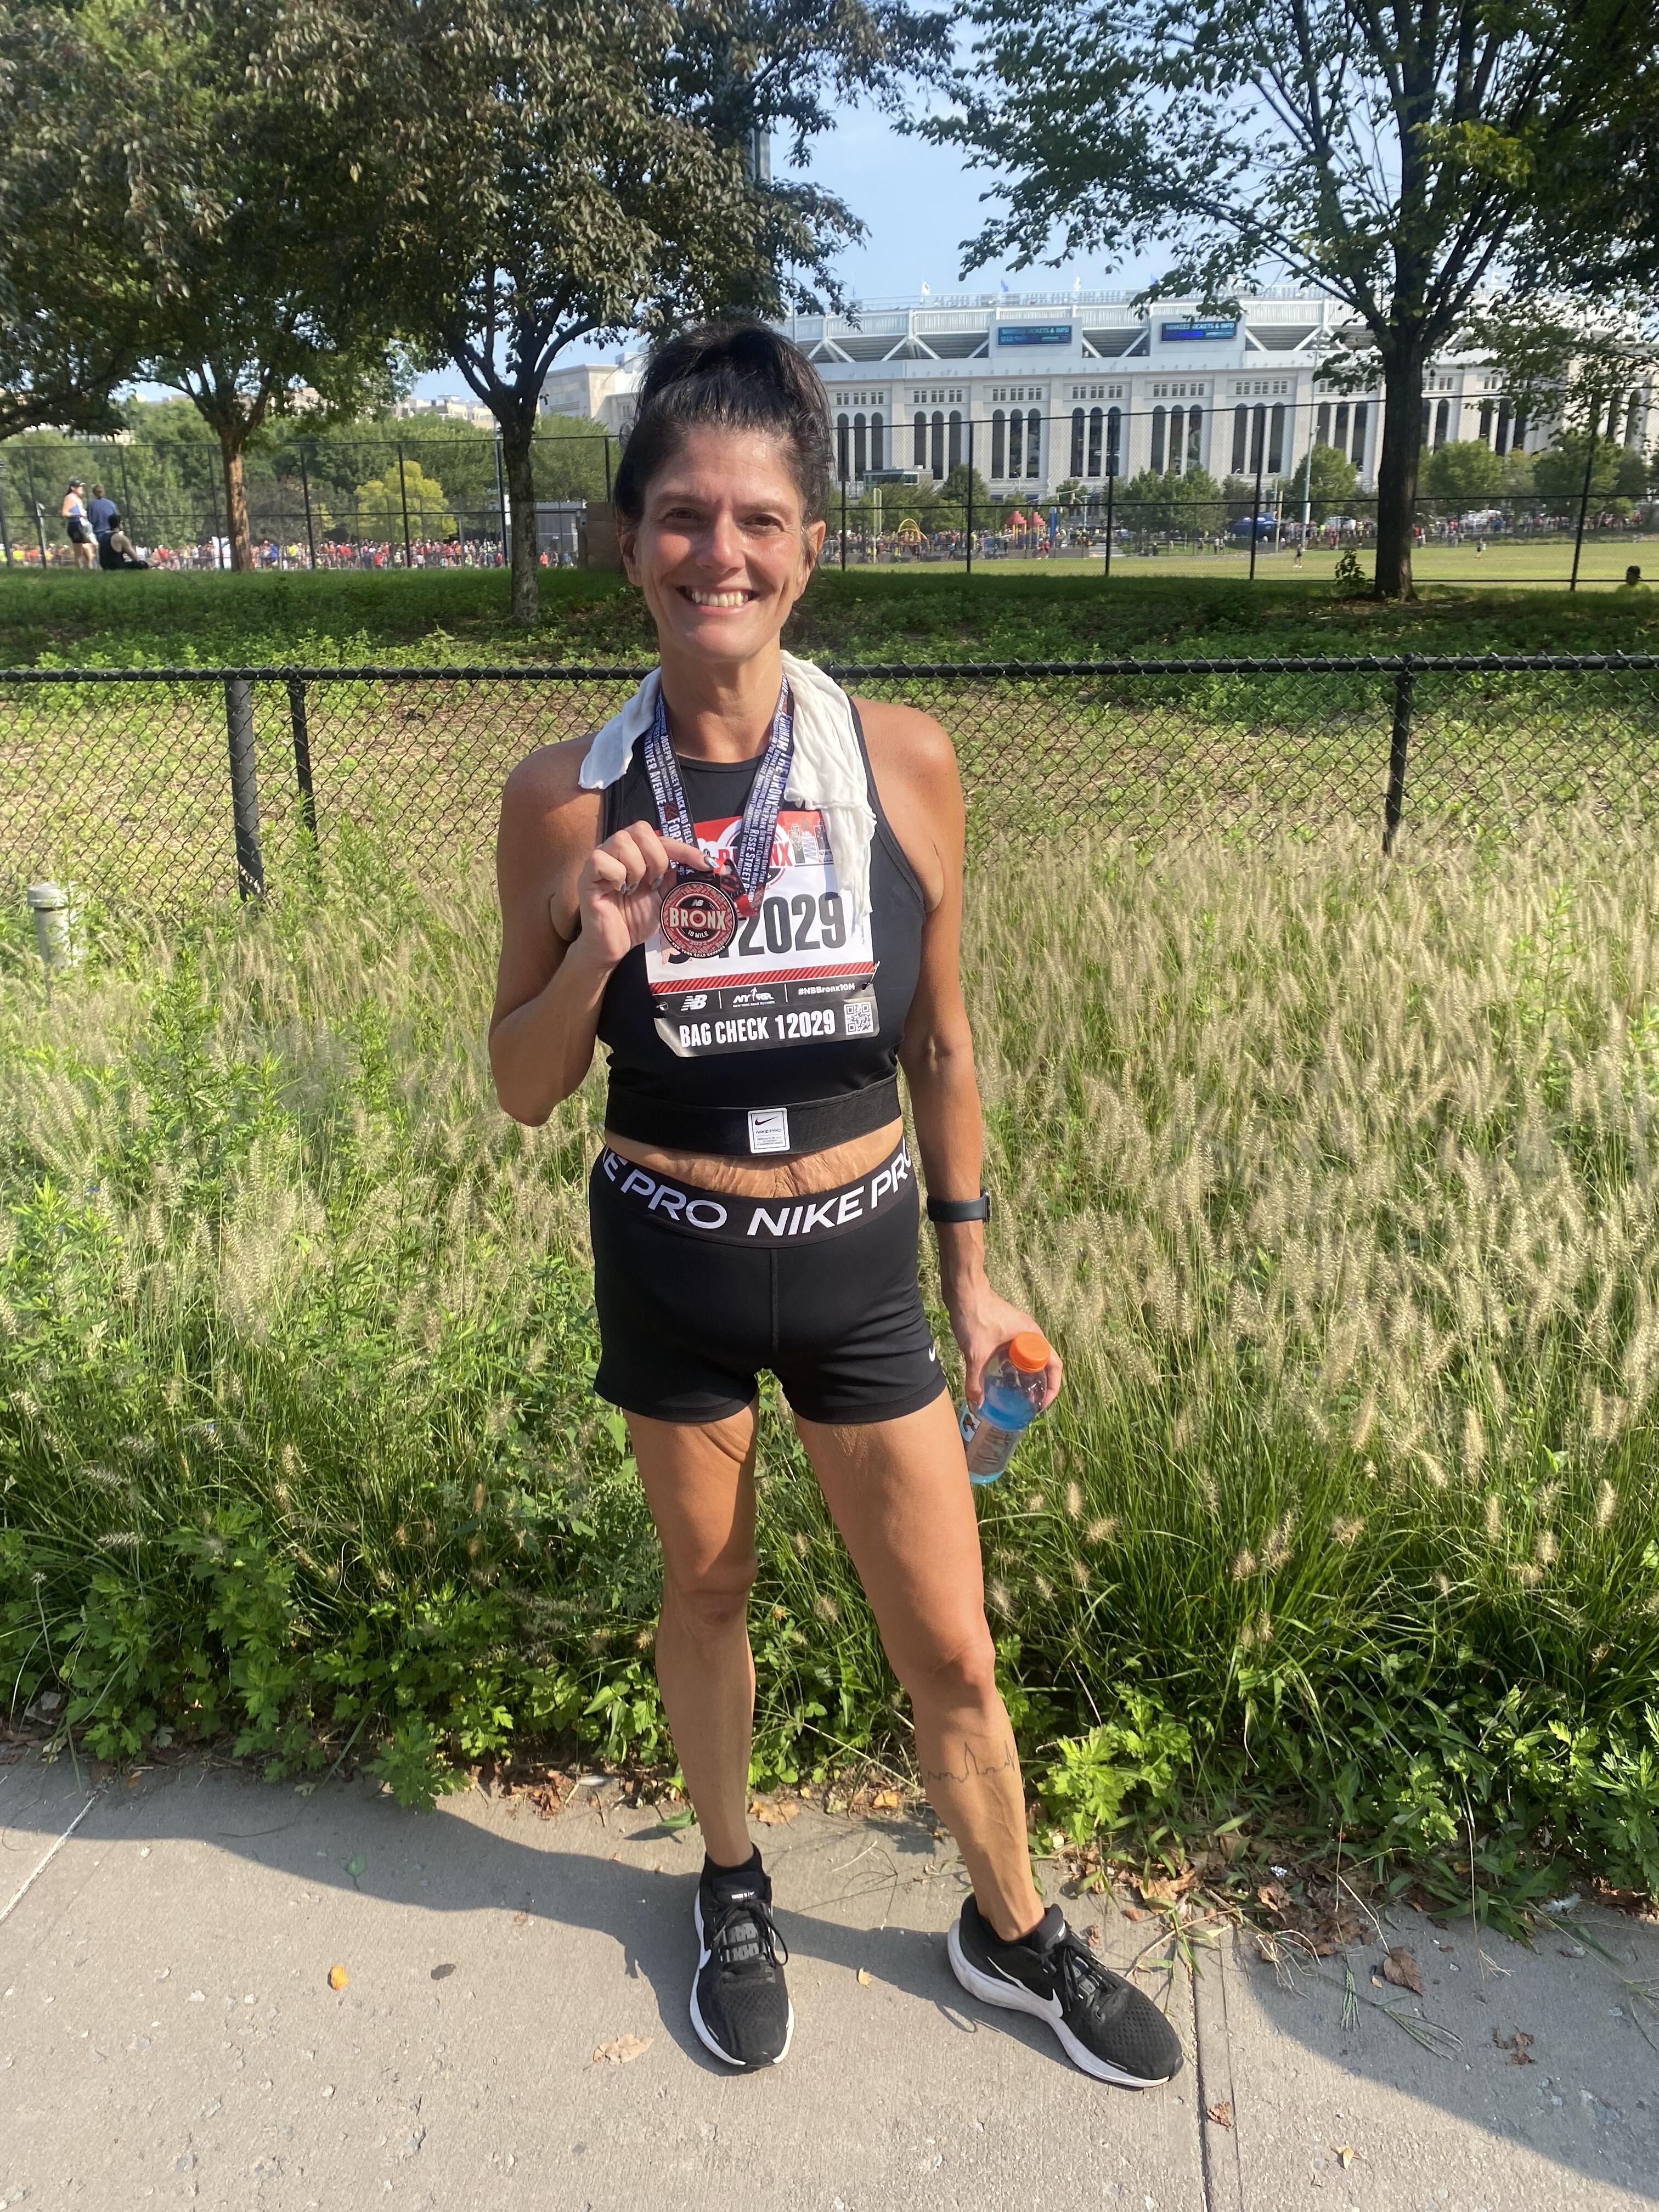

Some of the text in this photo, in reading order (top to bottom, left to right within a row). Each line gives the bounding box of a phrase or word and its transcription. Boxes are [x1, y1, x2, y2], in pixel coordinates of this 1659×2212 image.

[644, 742, 657, 771] RIVER
[661, 735, 673, 761] JOSEPH
[667, 759, 680, 787] YANCEY
[649, 771, 667, 806] AVENUE
[674, 786, 686, 810] TRACK
[679, 810, 689, 824] AND
[752, 809, 762, 827] SCHOOL
[759, 814, 769, 830] PARK
[682, 823, 694, 844] FIELD
[747, 828, 760, 852] RISSE
[741, 852, 755, 882] STREET
[669, 907, 726, 930] BRONX
[719, 891, 847, 958] 2029
[798, 983, 855, 996] #NBBronx10M
[679, 1009, 836, 1047] BAG CHECK 12029
[620, 1169, 727, 1229] PRO
[747, 1186, 865, 1236] NIKE
